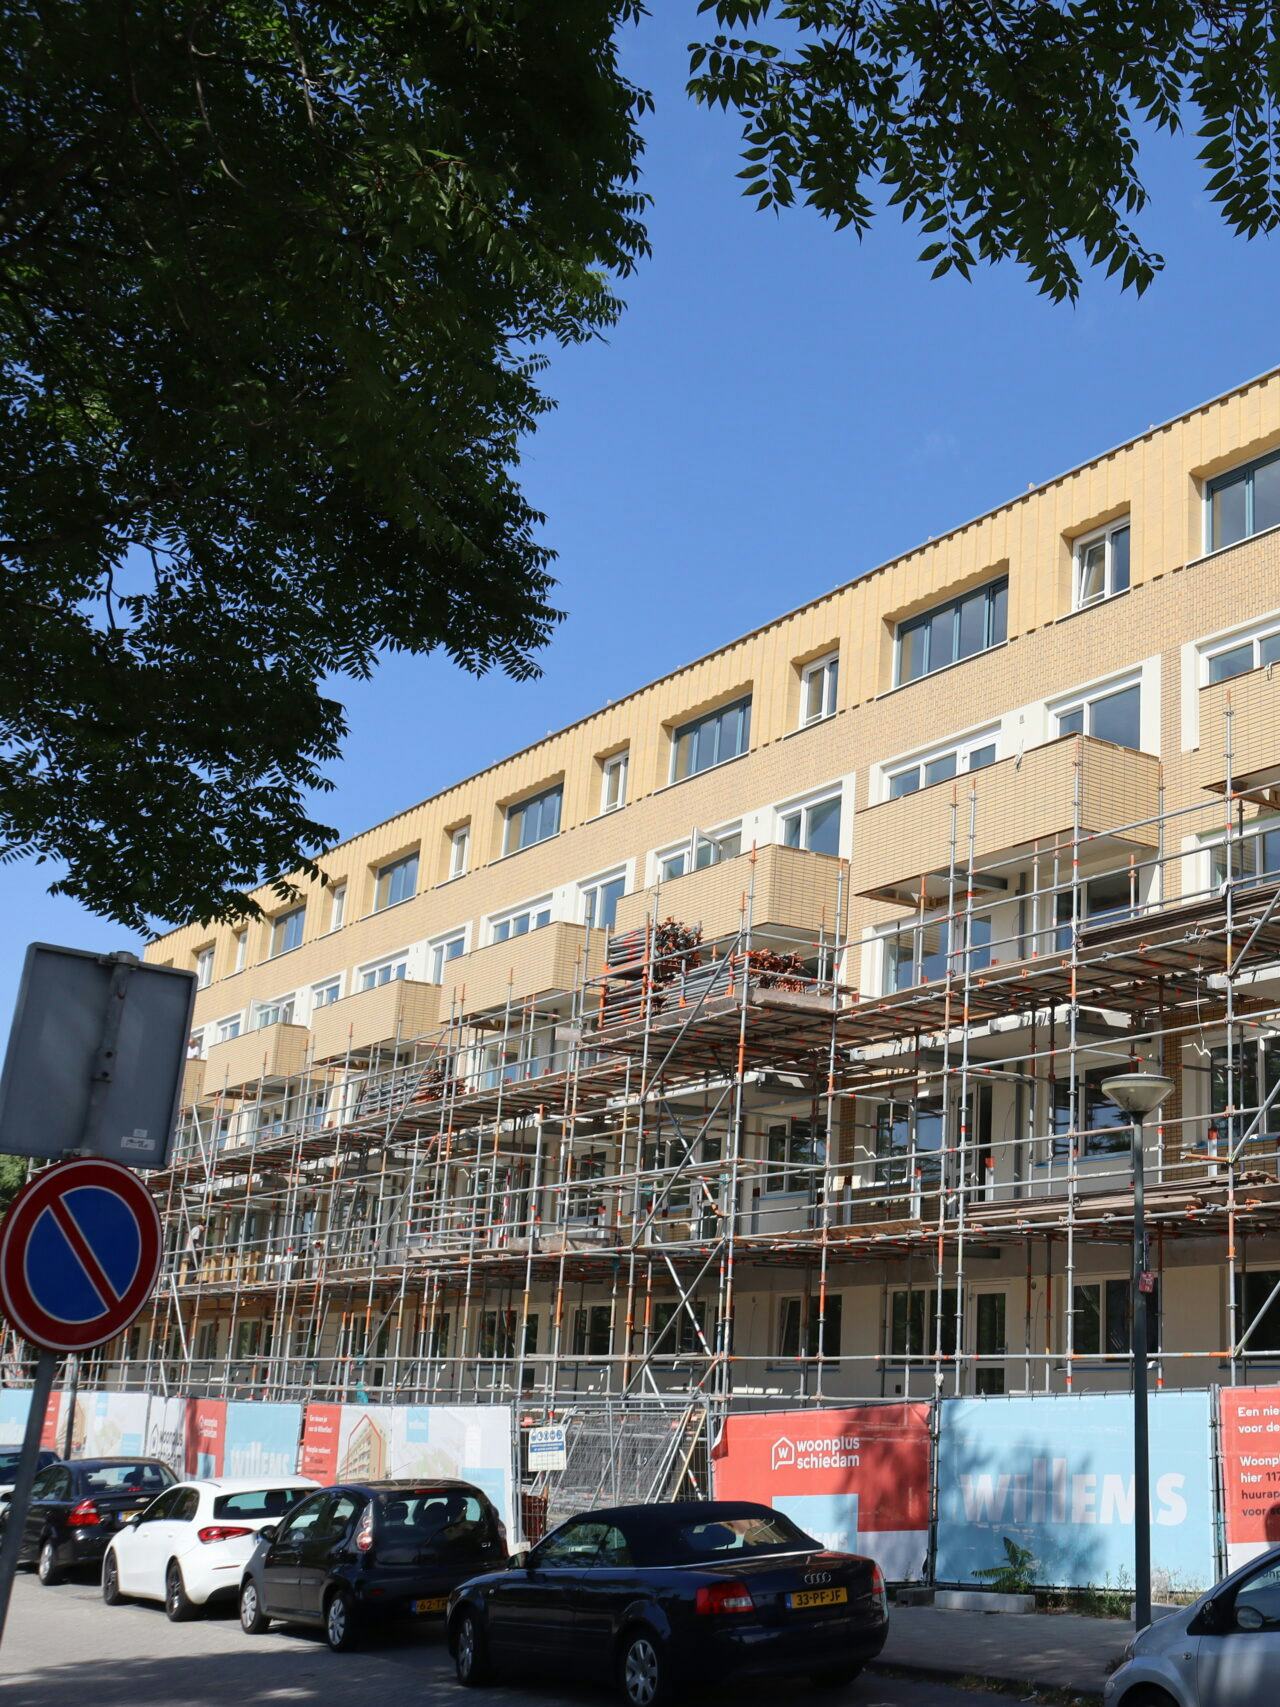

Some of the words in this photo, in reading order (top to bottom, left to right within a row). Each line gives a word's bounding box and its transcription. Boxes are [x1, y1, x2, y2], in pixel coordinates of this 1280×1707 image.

[1237, 1406, 1260, 1417] Een
[1238, 1424, 1262, 1433] voor
[1266, 1422, 1280, 1432] de
[796, 1436, 860, 1455] woonplus
[796, 1452, 860, 1469] schiedam
[1240, 1472, 1263, 1483] hier
[1242, 1507, 1266, 1517] voor
[796, 1590, 842, 1606] 33-PF-JF
